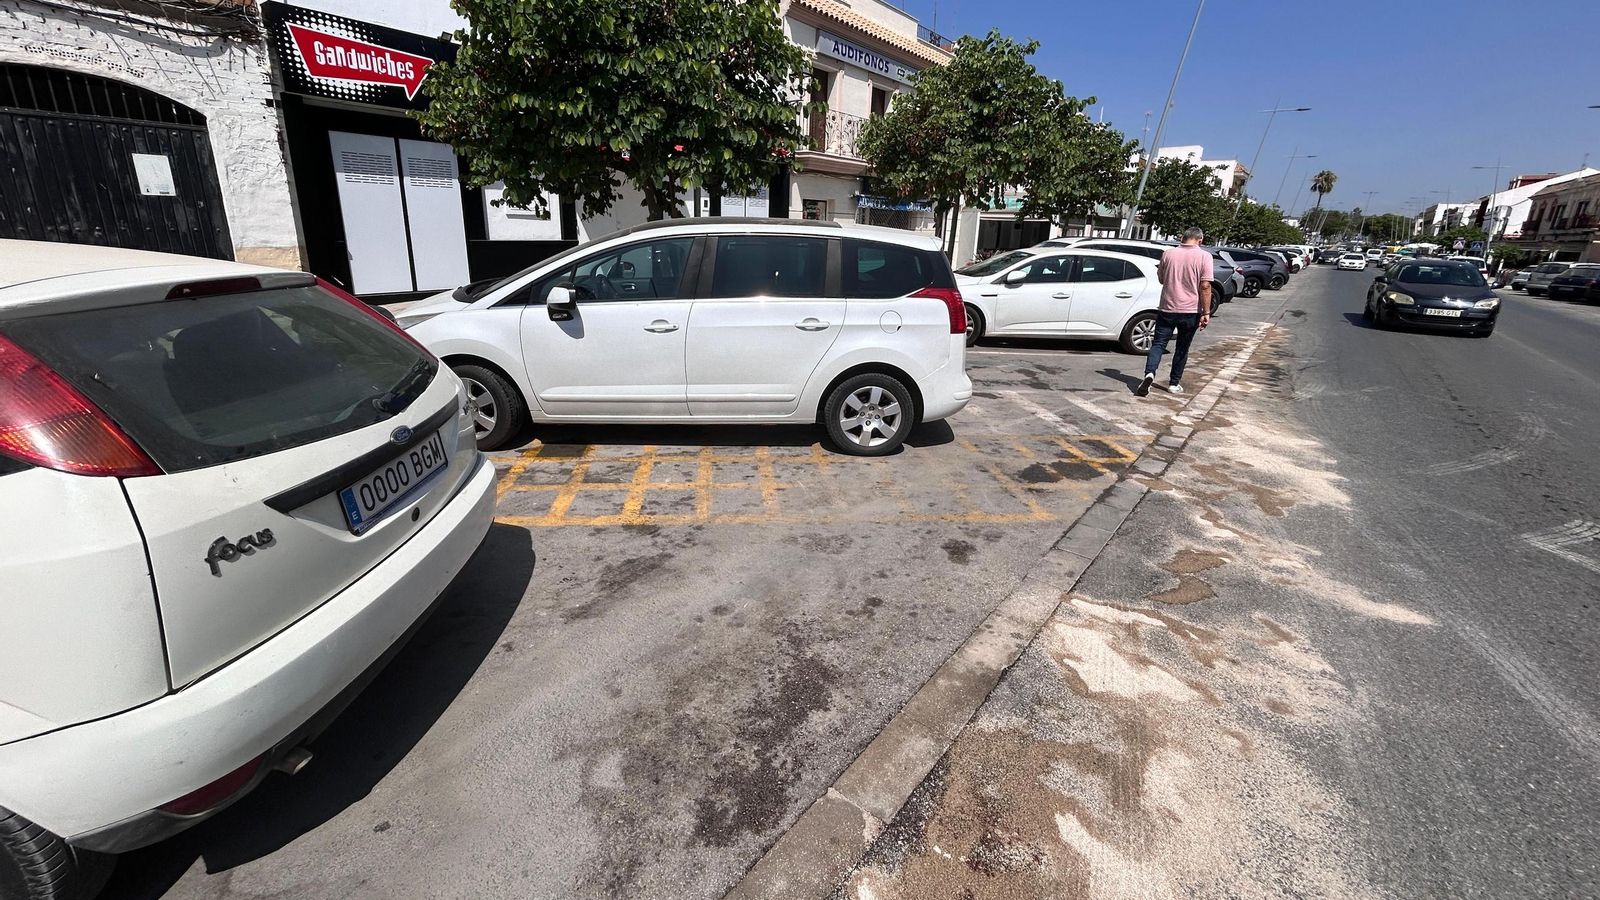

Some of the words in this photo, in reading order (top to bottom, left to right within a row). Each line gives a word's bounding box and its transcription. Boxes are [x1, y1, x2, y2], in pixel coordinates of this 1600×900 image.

[314, 41, 414, 80] Sandwiches
[832, 40, 889, 73] AUDIFONOS
[360, 460, 409, 512] 0000
[409, 437, 442, 478] BGM
